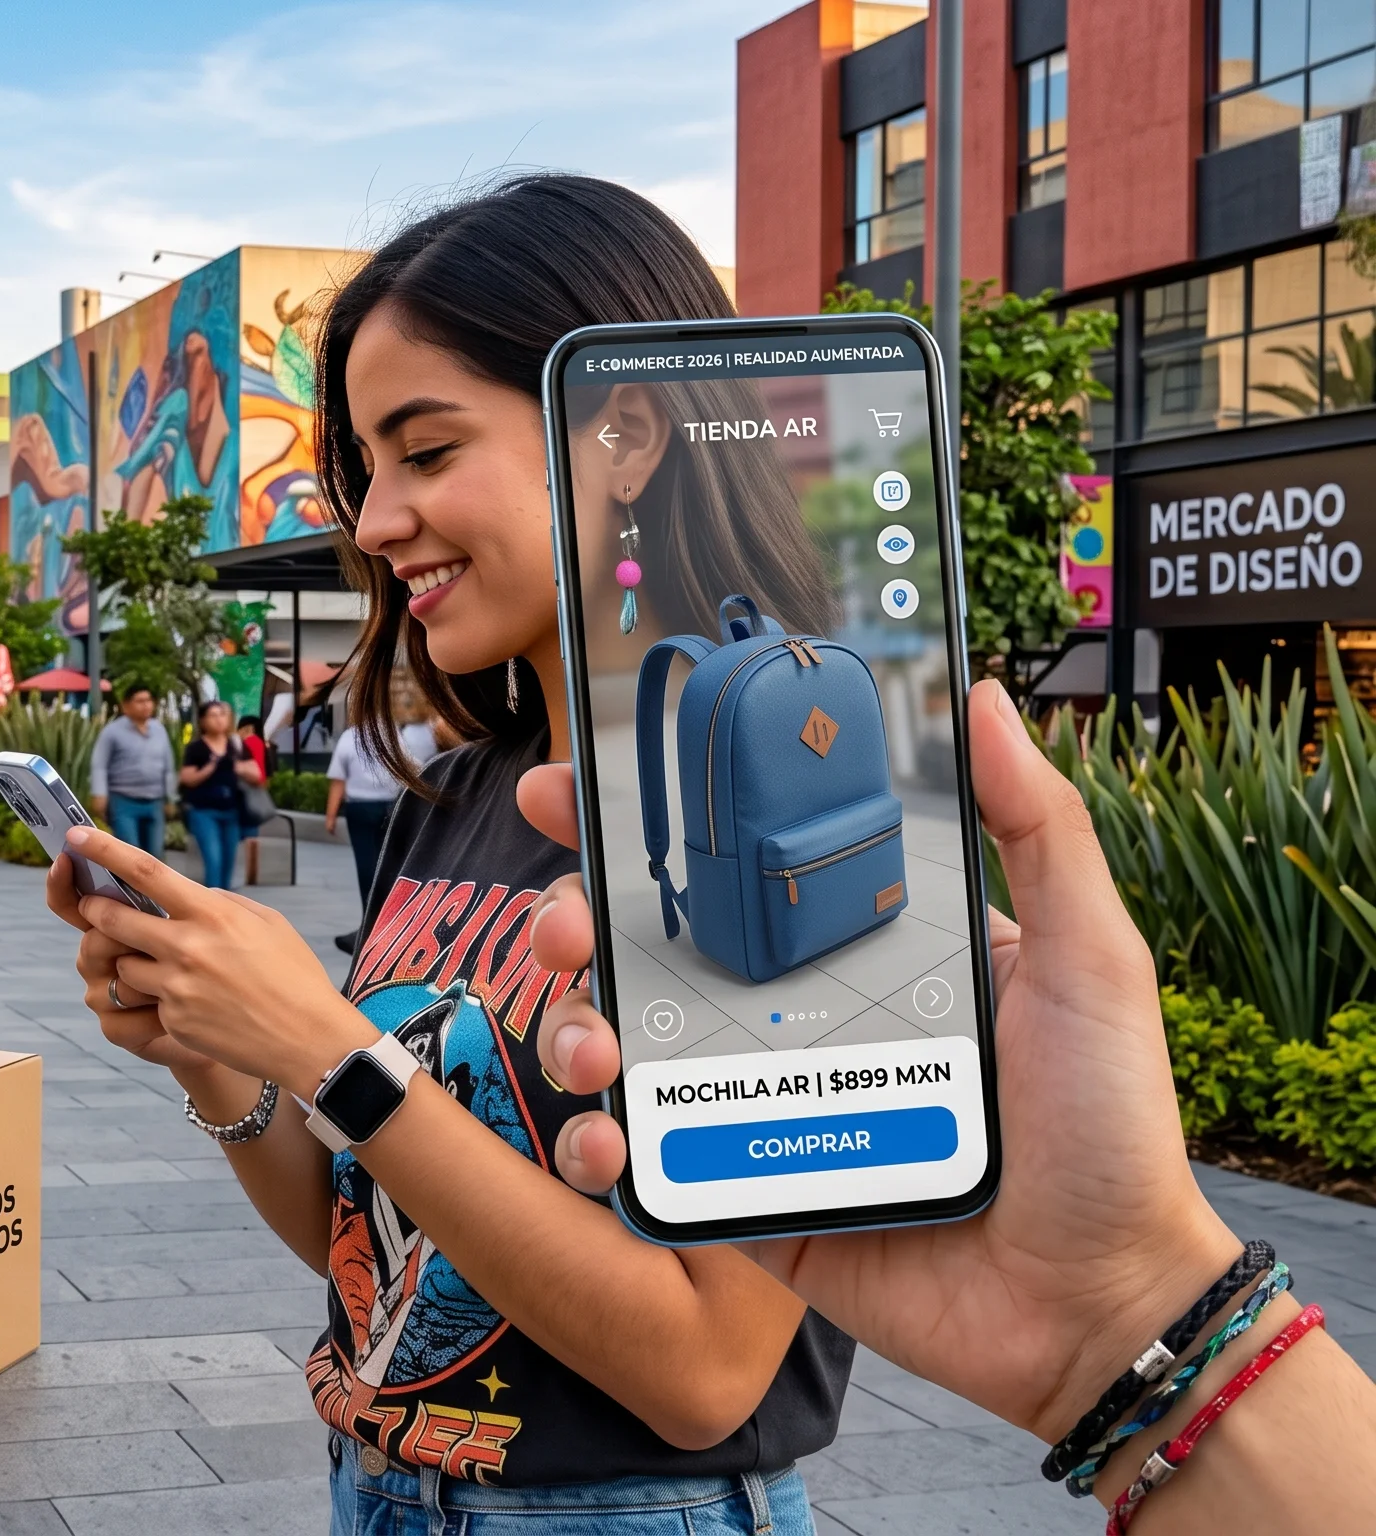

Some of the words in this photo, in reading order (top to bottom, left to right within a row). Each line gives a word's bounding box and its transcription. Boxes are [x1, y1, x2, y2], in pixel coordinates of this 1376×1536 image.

[586, 356, 684, 372] E-COMMERCE
[688, 354, 722, 368] 2026
[734, 350, 808, 366] REALIDAD
[810, 346, 904, 363] AUMENTADA
[684, 420, 778, 442] TIENDA
[783, 417, 818, 438] AR
[1150, 483, 1346, 544] MERCADO
[1150, 554, 1198, 599] DE
[1209, 532, 1363, 595] DISEÑO
[656, 1078, 771, 1106] MOCHILA
[776, 1074, 810, 1096] AR
[829, 1067, 889, 1095] $899
[895, 1062, 951, 1087] MXN
[748, 1130, 871, 1159] COMPRAR
